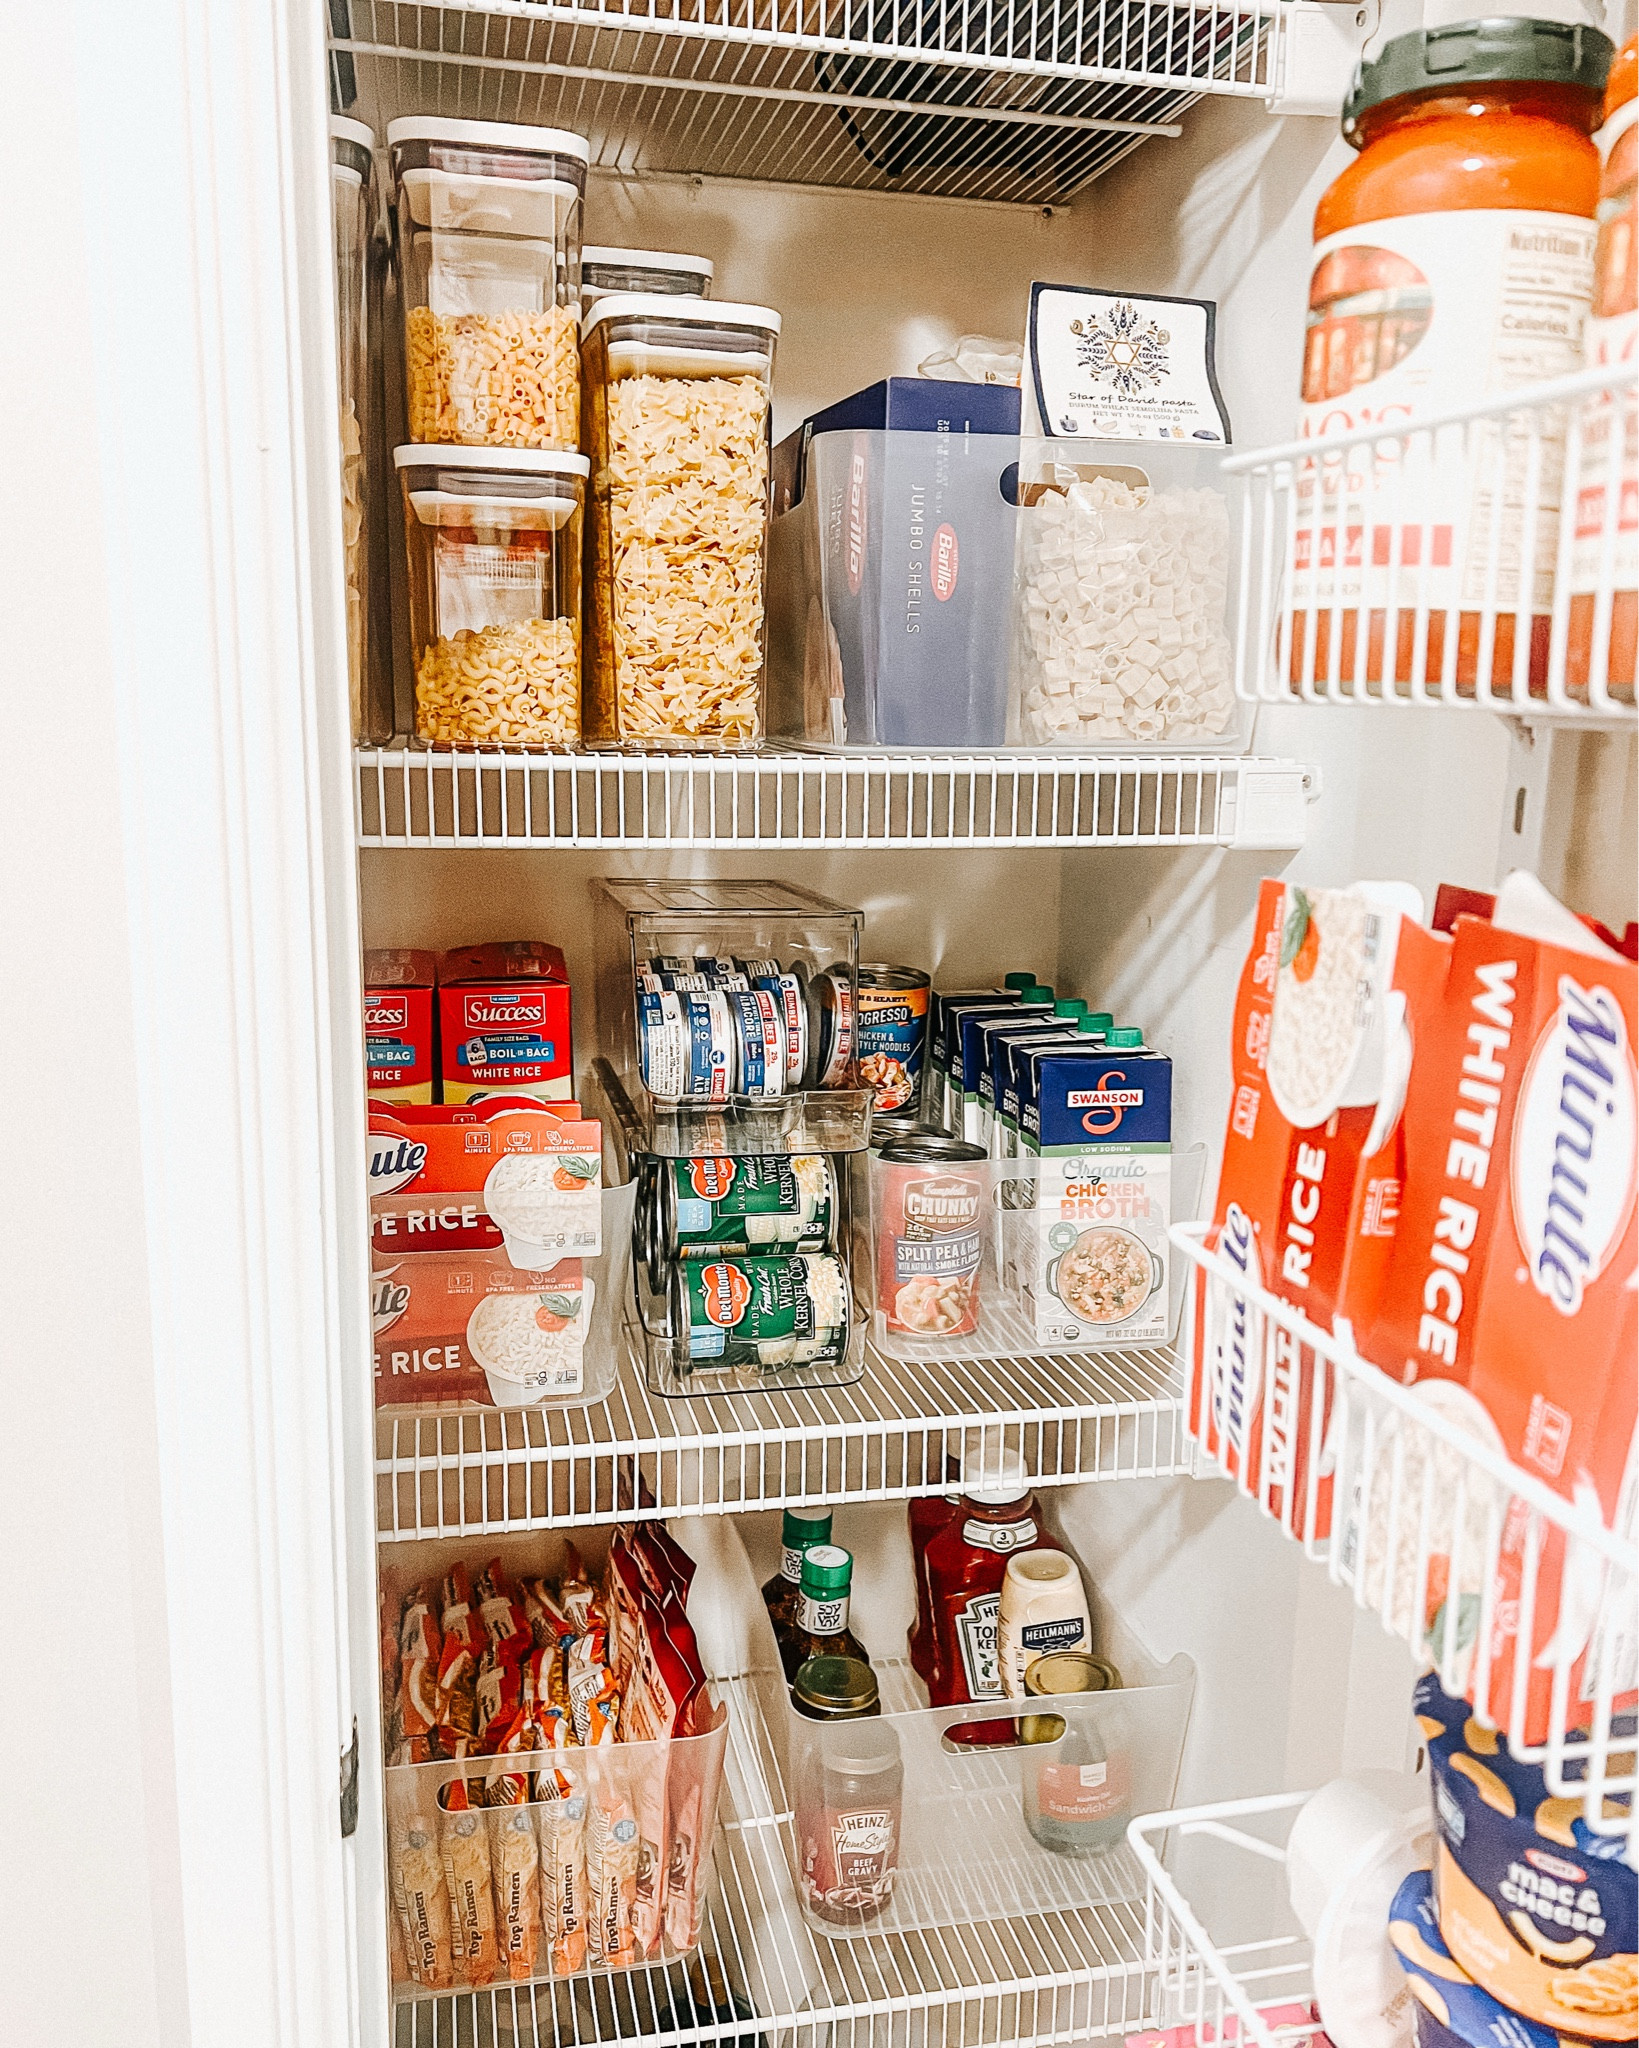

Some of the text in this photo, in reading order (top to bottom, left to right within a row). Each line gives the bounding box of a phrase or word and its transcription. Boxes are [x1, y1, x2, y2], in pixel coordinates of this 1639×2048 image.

[1068, 391, 1197, 407] Star of David pasta
[849, 454, 865, 576] Barilla
[906, 484, 926, 634] JUMBO SHELLS
[937, 532, 953, 595] Barilla
[364, 1009, 404, 1024] cess
[468, 1001, 542, 1023] Success
[785, 992, 798, 1027] BUMBLE
[858, 1007, 908, 1026] OGRESSO
[470, 1043, 479, 1054] 6
[789, 1033, 799, 1052] BEE
[858, 1030, 895, 1042] HICKEN &
[859, 1040, 911, 1052] TYLE NOODLES
[372, 1070, 402, 1081] RICE
[472, 1066, 542, 1078] WHITE RICE
[1072, 1092, 1139, 1105] SWANSON
[1100, 1145, 1131, 1153] SODIUM
[1537, 984, 1622, 1306] Minute
[369, 1140, 426, 1178] ute
[1417, 959, 1519, 1366] WHITE RICE
[779, 1161, 794, 1205] KERNEL
[1062, 1158, 1148, 1186] Organic
[736, 1180, 747, 1212] MADE
[1065, 1182, 1146, 1198] CHICKEN
[907, 1192, 979, 1217] CHUNKY
[1060, 1197, 1151, 1220] BROTH
[1282, 1141, 1328, 1289] RICE
[407, 1204, 479, 1234] RICE
[897, 1246, 933, 1261] SPLIT
[935, 1243, 960, 1261] PEA
[960, 1244, 967, 1256] &
[935, 1258, 961, 1271] SMOKE
[716, 1264, 734, 1323] Del Monte
[776, 1267, 794, 1311] WHOLE
[793, 1281, 810, 1330] KERNEL
[750, 1304, 761, 1338] MADE
[391, 1344, 462, 1376] RICE
[1000, 1531, 1007, 1541] 3
[1025, 1620, 1082, 1642] HELLMANN'S
[1048, 1799, 1106, 1815] Sandwich
[846, 1816, 885, 1831] HEINZ
[847, 1864, 878, 1876] GRAVY
[853, 1857, 874, 1868] BEEF
[562, 1863, 574, 1916] Ramen
[464, 1879, 484, 1958] Top Ramen
[507, 1871, 525, 1951] Top Ramen
[414, 1890, 437, 1969] Top Ramen
[606, 1925, 620, 1952] Top
